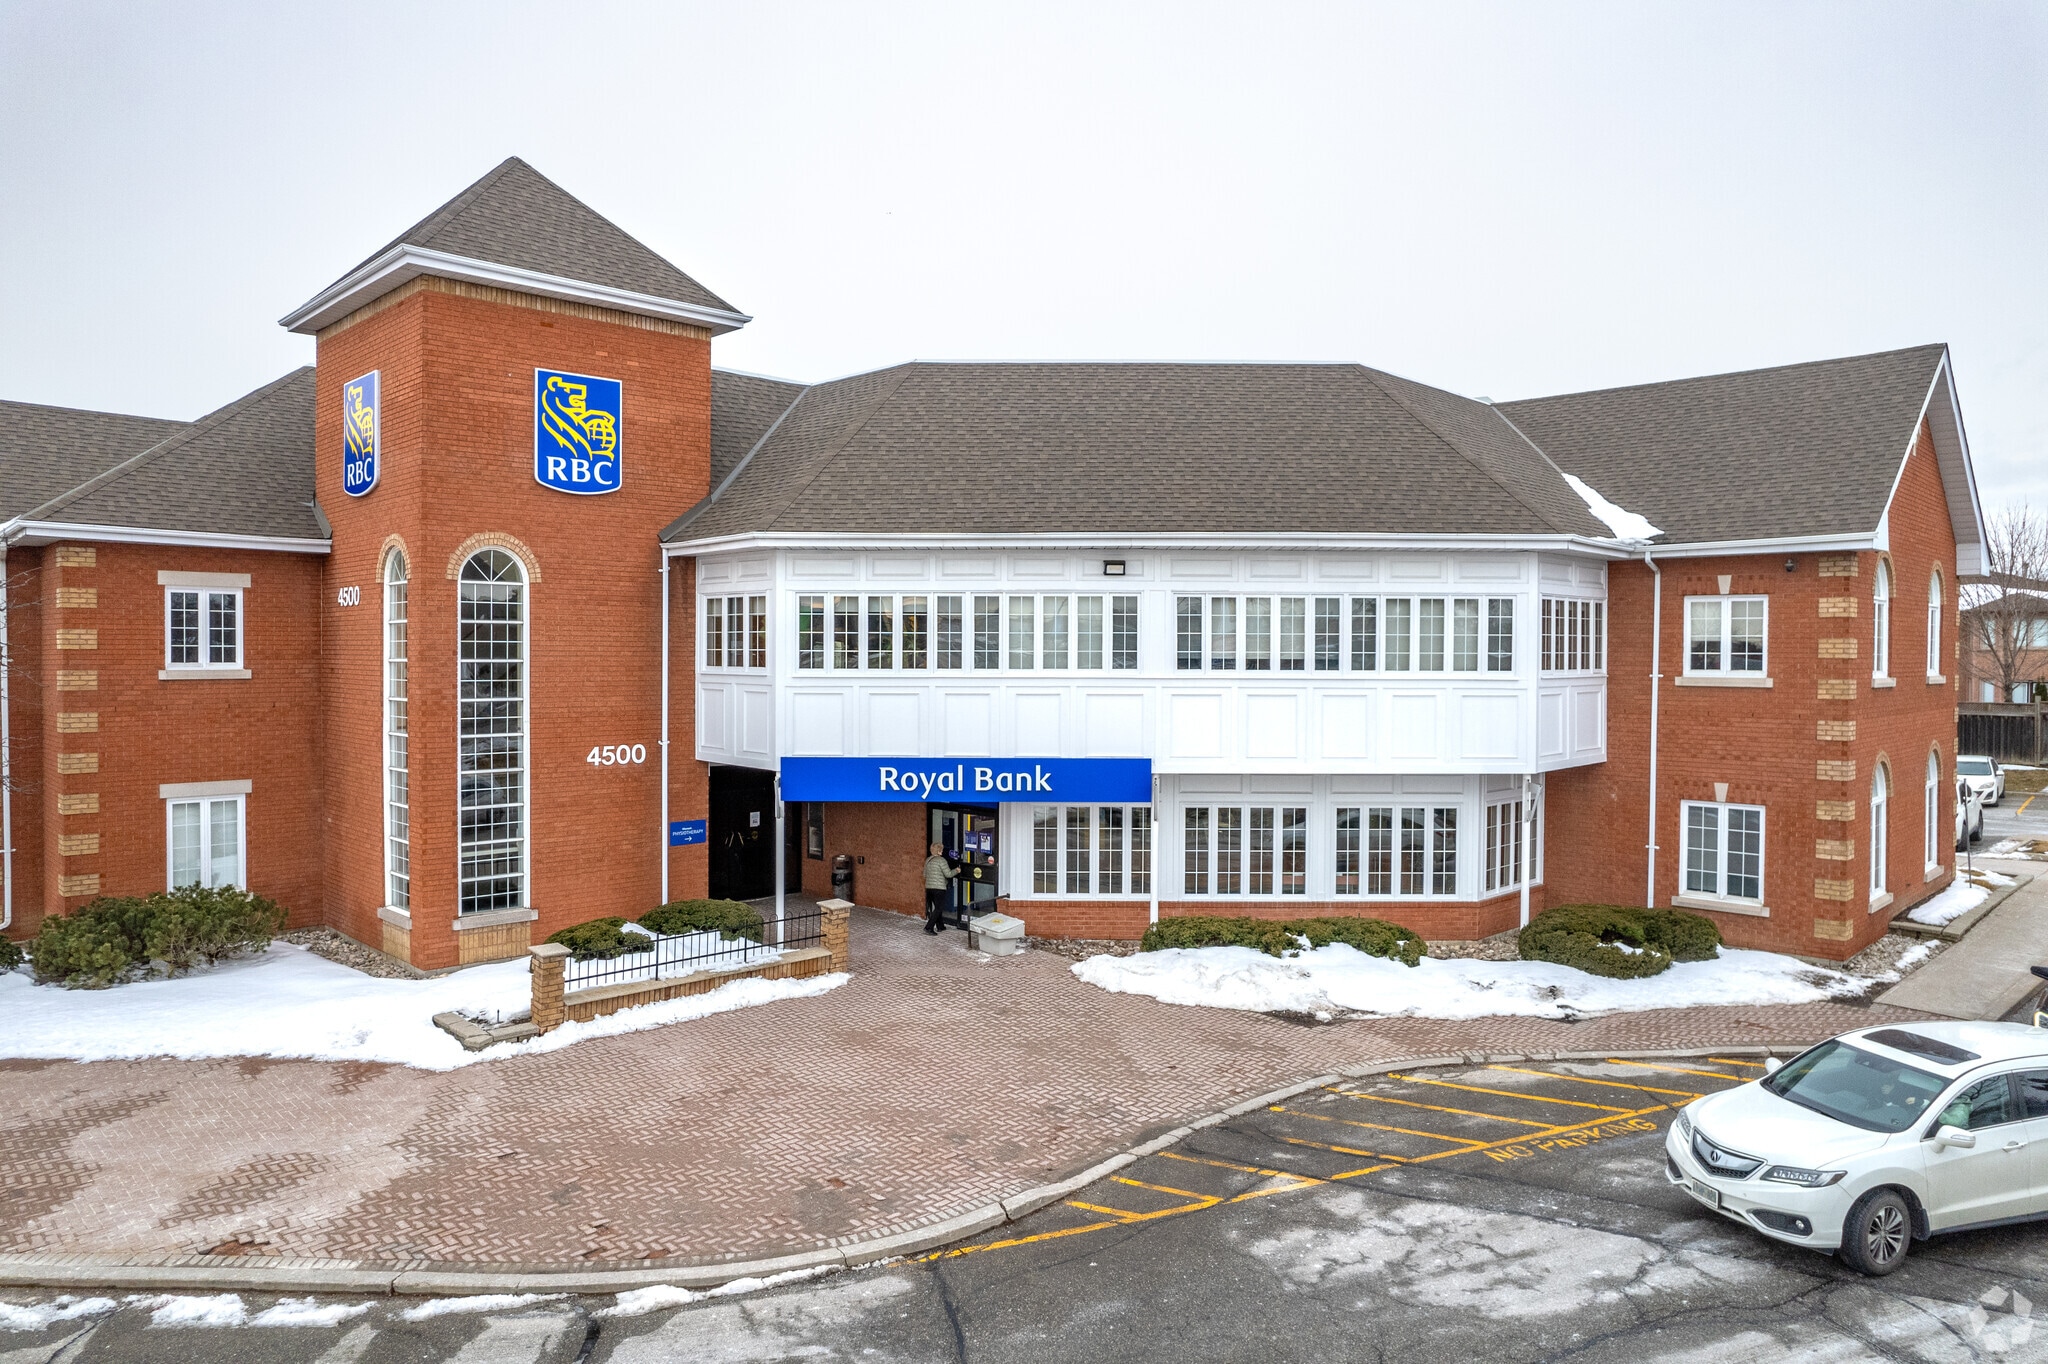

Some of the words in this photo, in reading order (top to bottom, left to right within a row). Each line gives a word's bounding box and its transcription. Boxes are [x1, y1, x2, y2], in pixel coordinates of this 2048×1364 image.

[347, 458, 372, 487] RBC
[546, 455, 613, 485] RBC
[337, 585, 360, 607] 4500
[586, 743, 647, 766] 4500
[879, 764, 964, 800] Royal
[974, 764, 1053, 792] Bank
[1482, 1145, 1535, 1163] NO
